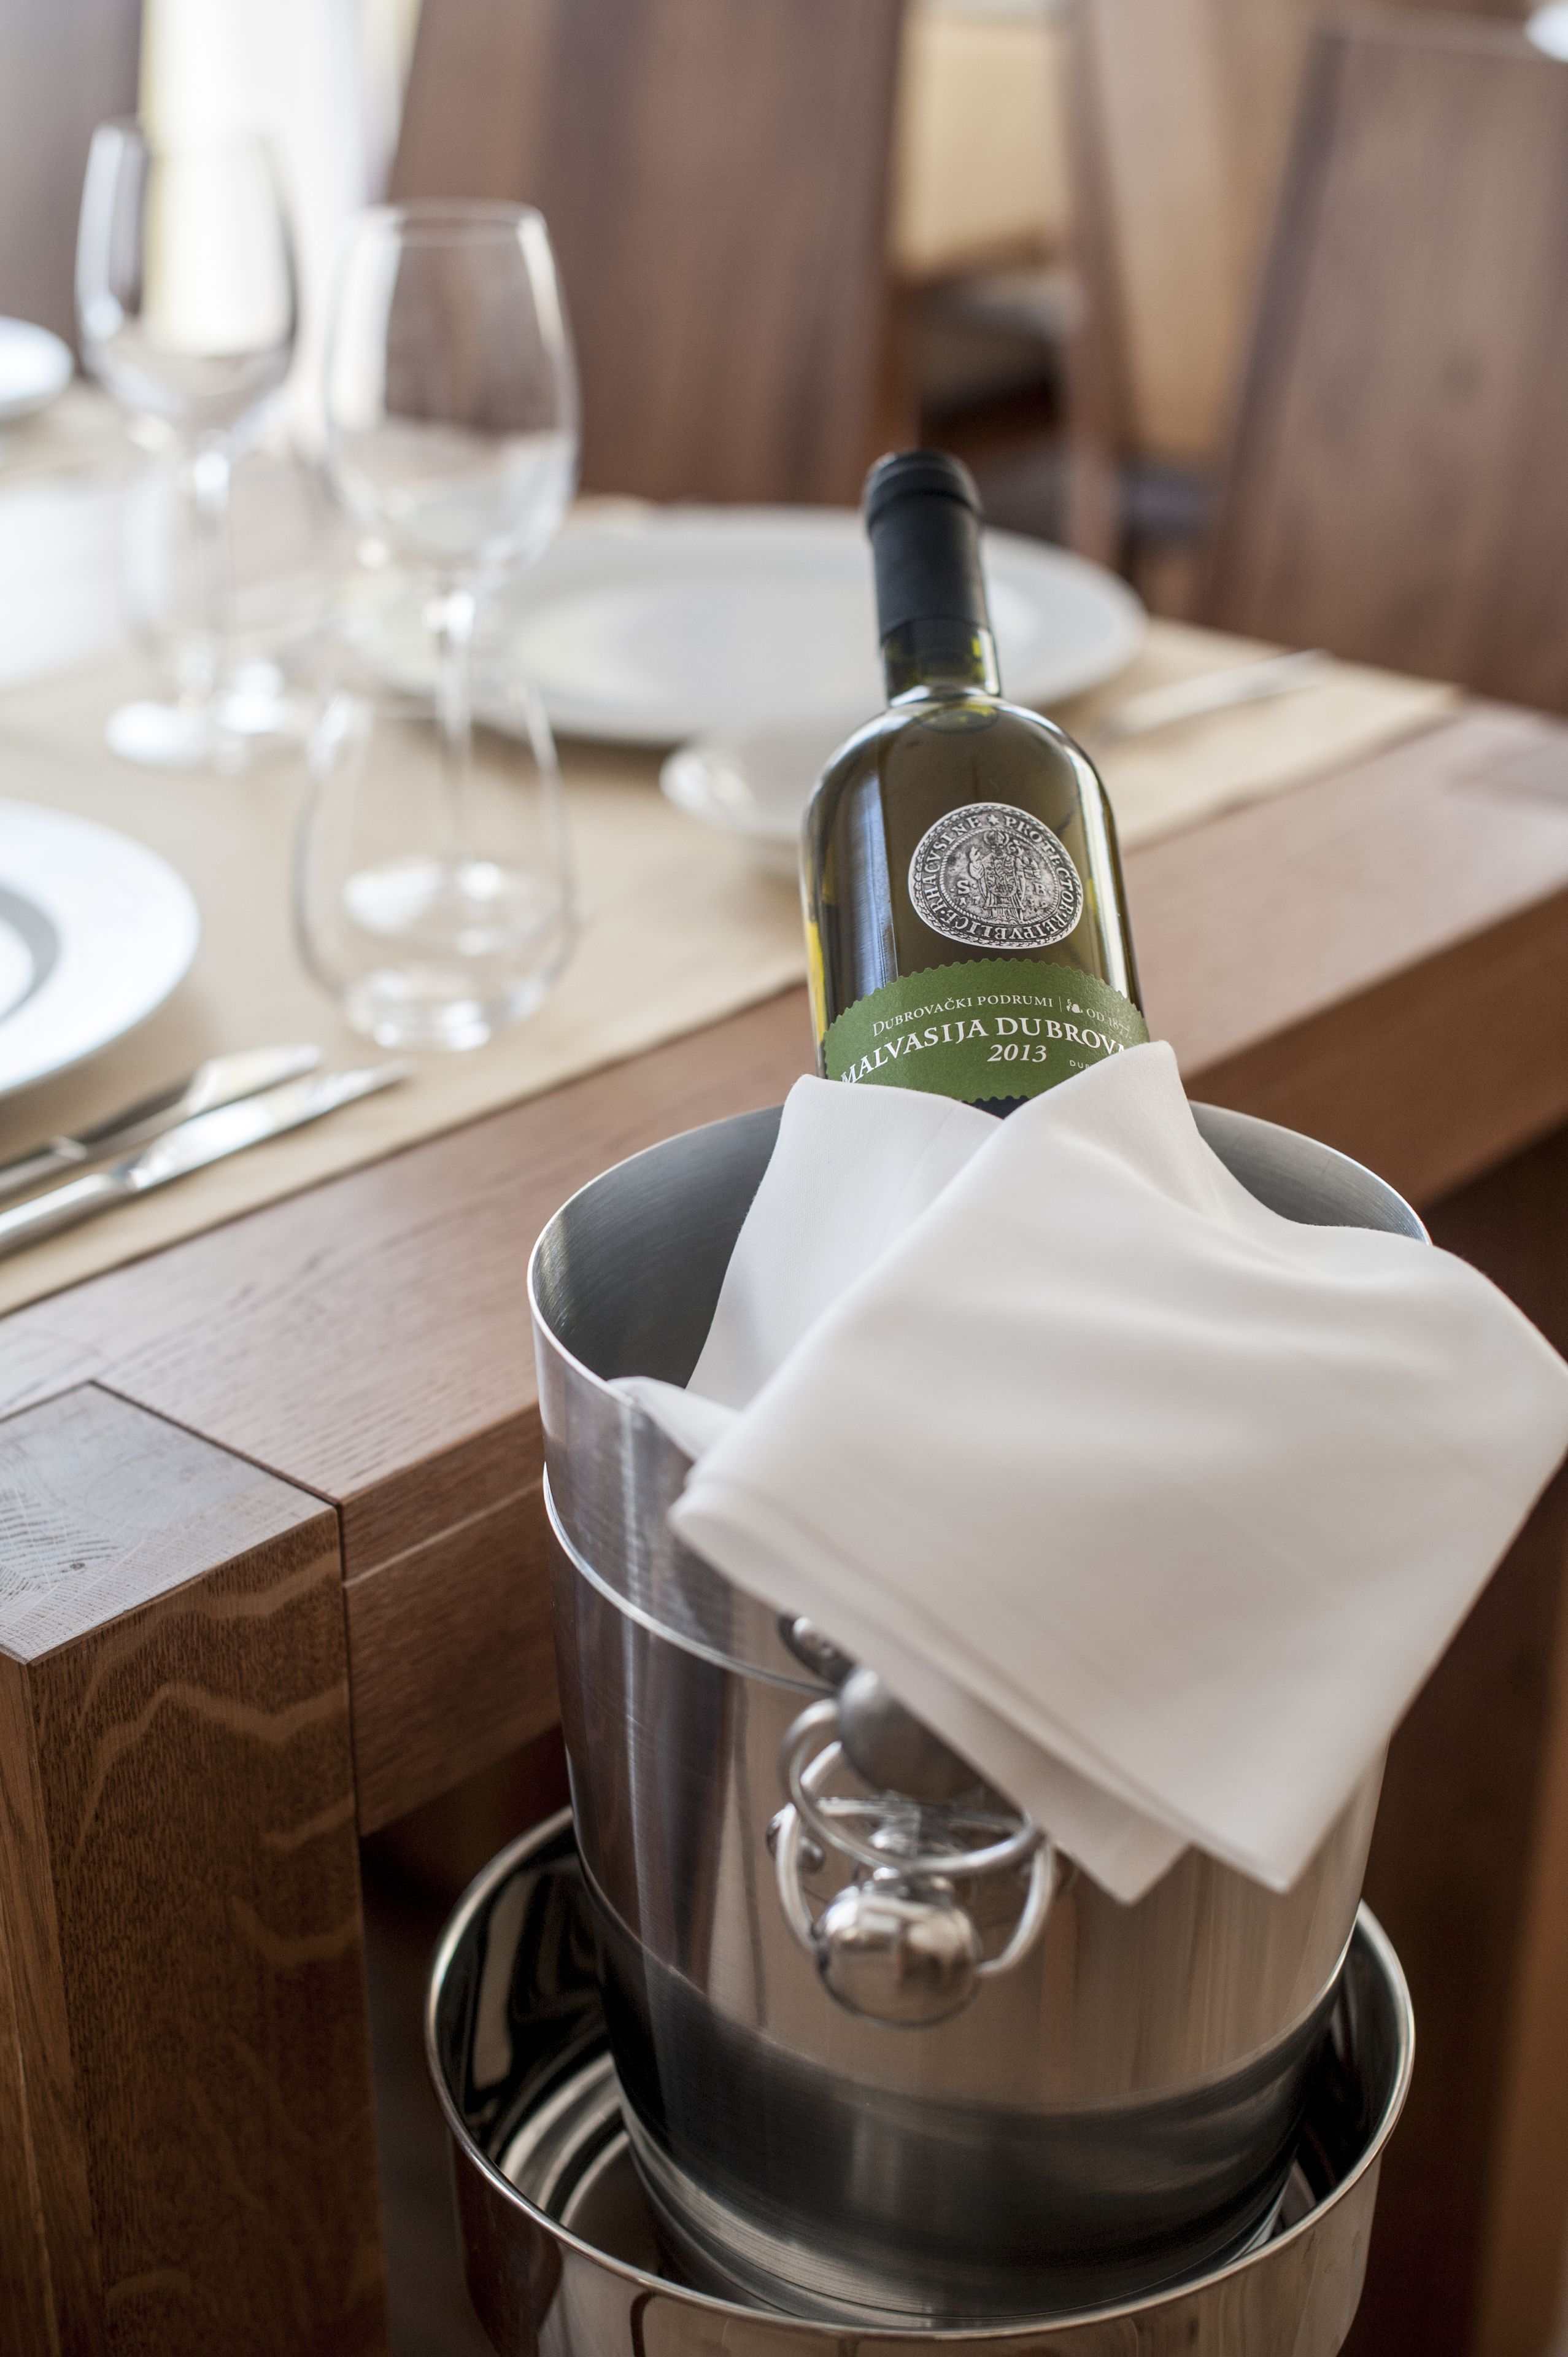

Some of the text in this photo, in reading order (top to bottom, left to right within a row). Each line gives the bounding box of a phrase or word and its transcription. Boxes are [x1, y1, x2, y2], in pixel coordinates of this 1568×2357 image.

[977, 994, 1054, 1007] PODRUMI
[1086, 1008, 1105, 1021] OD
[841, 1019, 989, 1083] MALVASIJA
[987, 1043, 1047, 1062] 2013
